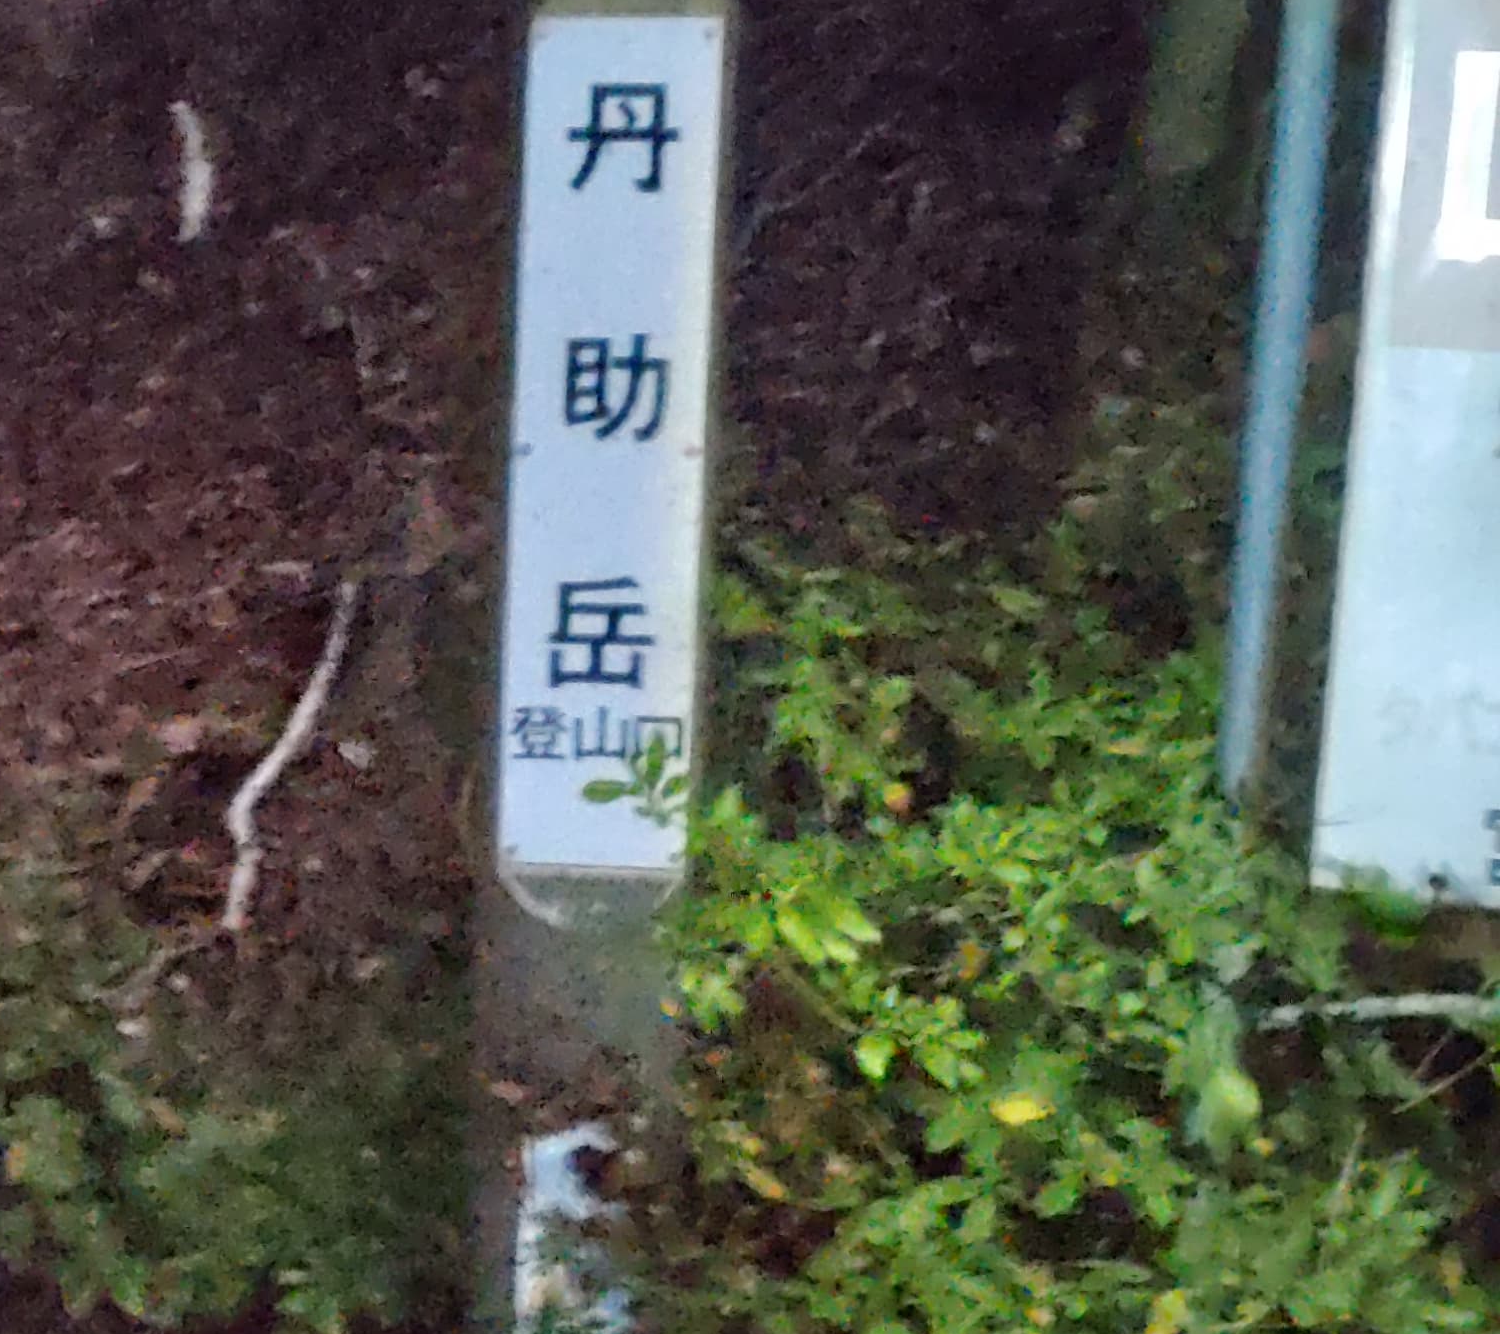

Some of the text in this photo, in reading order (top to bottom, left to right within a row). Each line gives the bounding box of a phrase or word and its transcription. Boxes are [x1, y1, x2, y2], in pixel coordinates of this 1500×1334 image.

[548, 82, 680, 689] 丹助岳
[510, 705, 682, 760] 登山口
